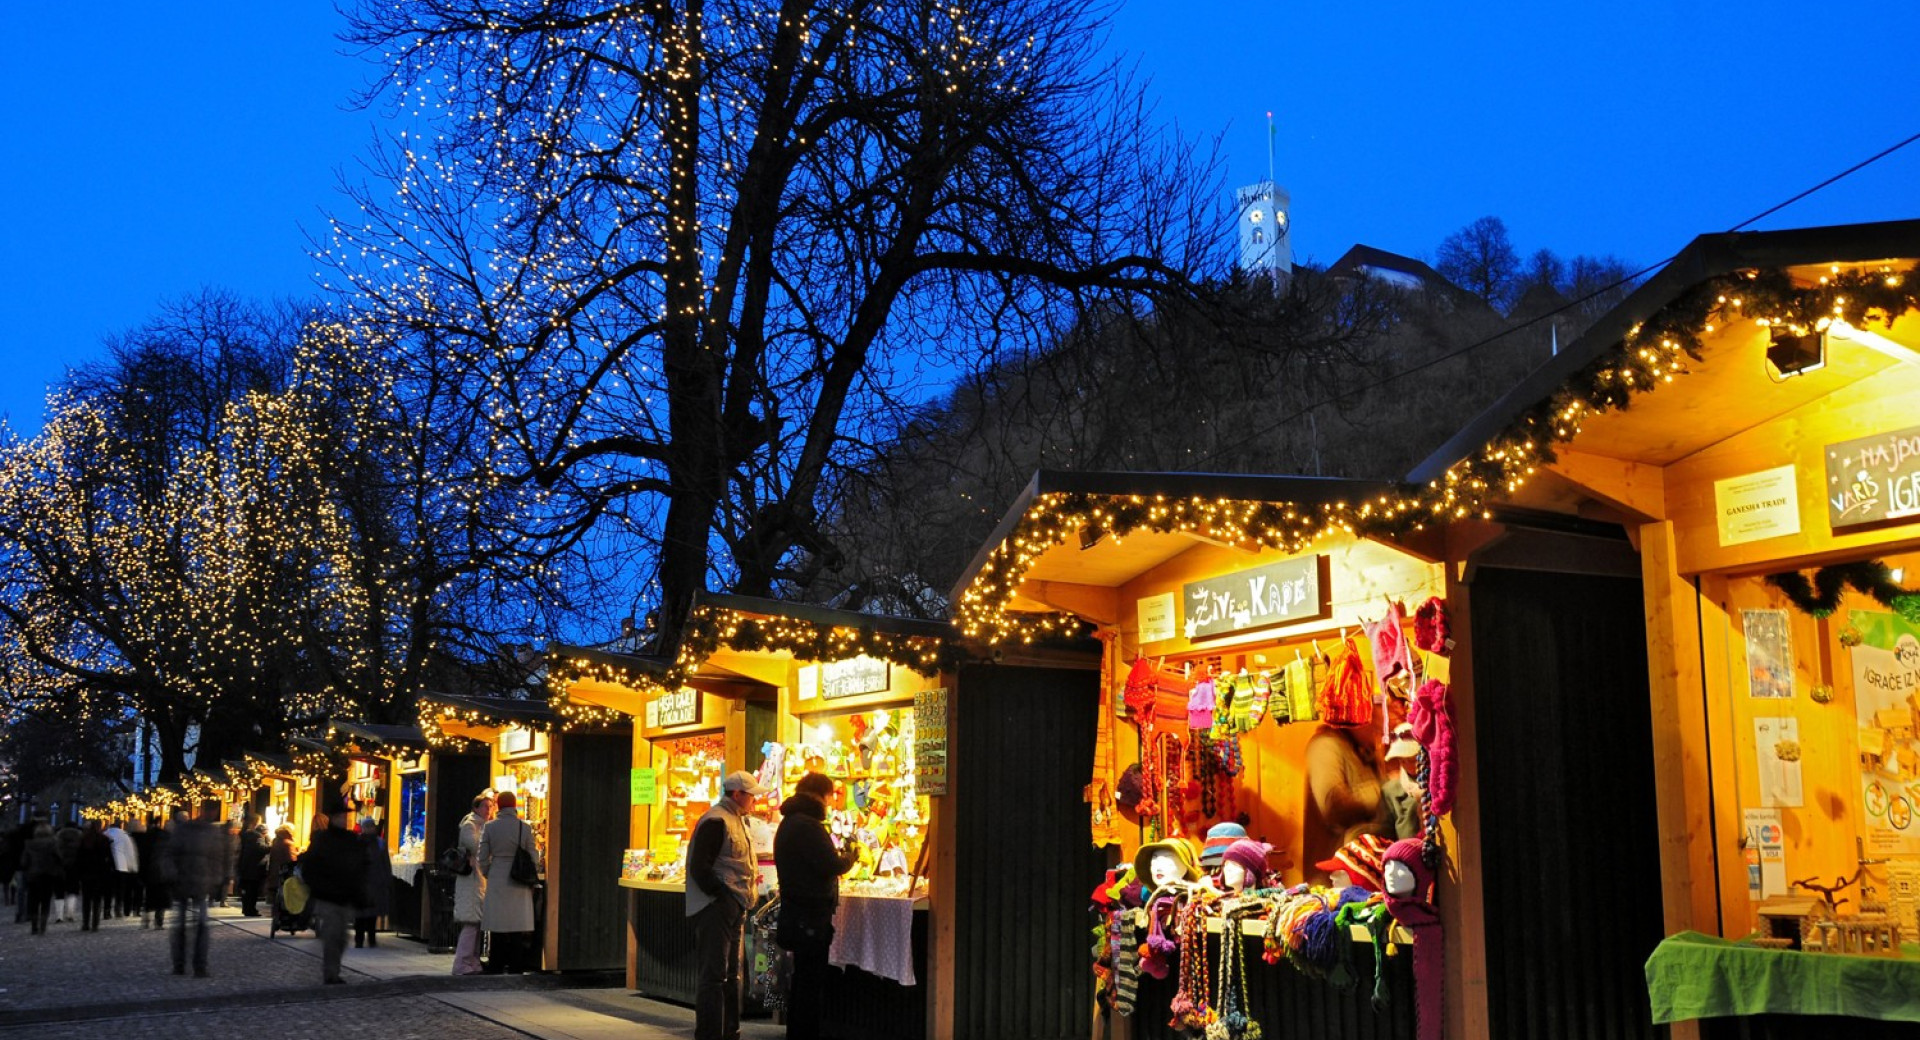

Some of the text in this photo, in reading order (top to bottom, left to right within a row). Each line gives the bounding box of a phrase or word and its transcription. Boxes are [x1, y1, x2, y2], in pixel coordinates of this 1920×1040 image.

[1726, 497, 1786, 516] GANESHA TRADE
[1863, 666, 1903, 691] IGRAČE
[1904, 672, 1914, 688] IZ
